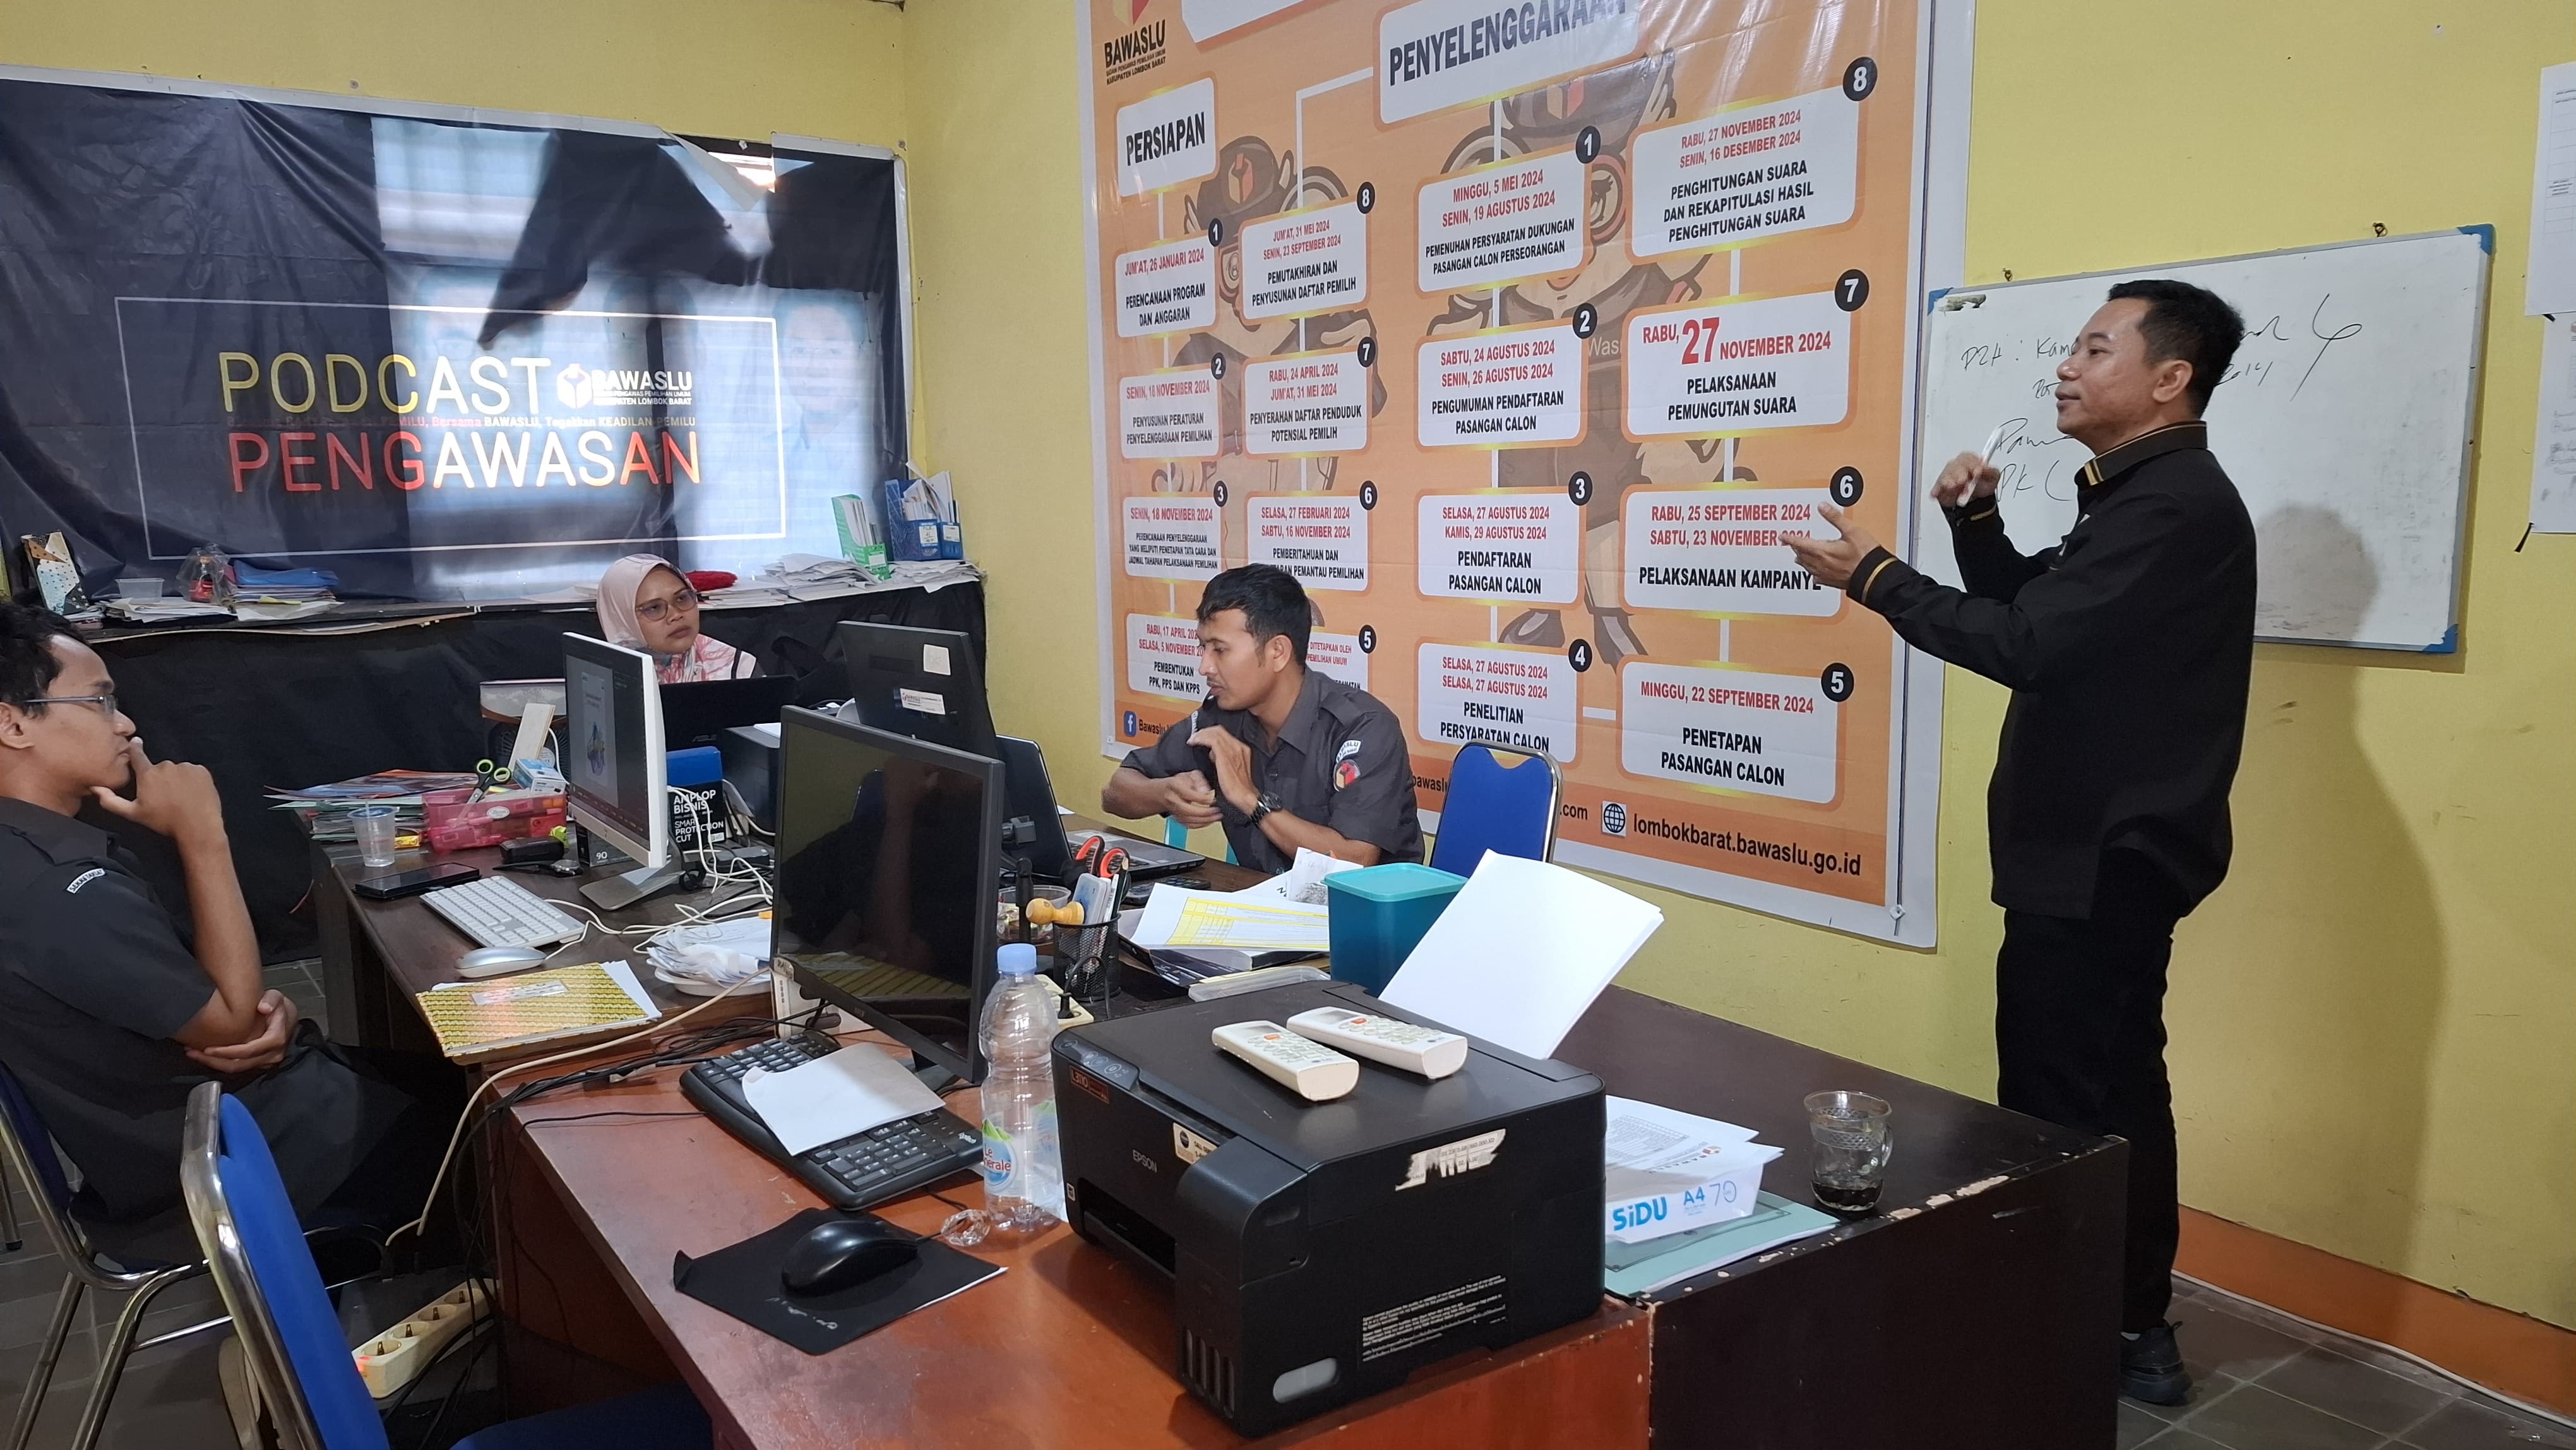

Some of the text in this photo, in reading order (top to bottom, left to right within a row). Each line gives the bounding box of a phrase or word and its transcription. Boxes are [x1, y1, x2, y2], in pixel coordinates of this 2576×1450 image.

[1104, 19, 1166, 68] BAWASLU
[1107, 57, 1166, 85] KABUPATEN LOMBOK BARAT
[1854, 66, 1867, 92] 8
[1126, 112, 1205, 166] PERSIAPAN
[1585, 134, 1592, 156] 1
[1453, 169, 1543, 203] MINGGU, 5 MEI 2024
[1671, 160, 1808, 200] PENGHITUNGAN SUARA
[1362, 189, 1369, 207] 8
[1664, 181, 1813, 222] DAN REKAPITULASI HASIL
[1213, 227, 1217, 240] 1
[1426, 218, 1574, 258] PEMENUHAN PERSYARATAN DUKUNGAN
[1125, 248, 1204, 276] JUM'AT, 26 JANUARI 2024
[1433, 240, 1565, 275] PASANGAN CALON PERSEORANGAN
[1266, 260, 1337, 284] PEMUTAKHIRAN DAN
[1126, 283, 1205, 309] PERENCANAAN PROGRAM
[1253, 277, 1356, 306] PENYUSUNAN DAFTAR PEMILIH
[1844, 279, 1859, 303] 7
[1140, 306, 1190, 327] DAN ANGGARAN
[1580, 311, 1590, 332] 2
[1643, 317, 1830, 364] RABU, 27 NOVEMBER 2024
[1363, 344, 1370, 361] 7
[1215, 358, 1222, 374] 2
[1270, 362, 1338, 383] RABU, 24 APRIL 2024
[218, 352, 551, 415] PODCAST
[591, 369, 693, 390] BAWASLU
[1688, 371, 1776, 395] PELAKSANAAN
[1433, 390, 1563, 414] PENGUMUMAN PENDAFTARAN
[1668, 395, 1797, 421] PEMUNGUTAN SUARA
[484, 416, 543, 428] BAWASLU,
[598, 417, 652, 427] KEADILAN
[657, 417, 696, 426] PEMILU
[1133, 412, 1203, 428] PENYUSUNAN PERATURAN
[1250, 405, 1361, 426] PENYERAHAN DAFTAR PENDUDUK
[1454, 416, 1538, 434] PASANGAN CALON
[1127, 429, 1212, 445] PENYELENGGARAAN PEMILIHAN
[1272, 426, 1337, 442] POTENSIAL PEMILIH
[228, 431, 700, 493] PENGAWASAN
[1217, 487, 1224, 501] 3
[1365, 487, 1372, 503] 6
[1575, 478, 1585, 498] 3
[1840, 476, 1853, 498] 6
[1261, 506, 1350, 521] SELASA, 27 FEBRUARI 2024
[1273, 548, 1338, 561] PEMBERITAHUAN DAN
[1457, 551, 1531, 568] PENDAFTARAN
[1294, 565, 1327, 577] PEMANTAU
[1329, 568, 1364, 580] PEMILIHAN
[1640, 566, 1736, 587] PELAKSANAAN
[1449, 575, 1541, 594] PASANGAN CALON
[1364, 632, 1371, 648] 5
[1575, 645, 1585, 666] 4
[1154, 661, 1194, 677] PEMBENTUKAN
[1443, 657, 1547, 680] SELASA, 27 AGUSTUS 2024
[1149, 676, 1200, 694] PPK, PPS DAN KPPS
[1831, 671, 1844, 693] 5
[1642, 681, 1813, 714] MINGGU, 22 SEPTEMBER 2024
[1464, 702, 1524, 724] PENELITIAN
[1681, 728, 1761, 755] PENETAPAN
[1662, 752, 1784, 786] PASANGAN CALON
[675, 818, 698, 829] SMAR
[676, 821, 724, 836] PROTCTION
[676, 834, 692, 842] CUT
[1634, 814, 1861, 875] lombokbarat.bawaslu.go.id
[596, 851, 607, 860] 90
[1133, 1149, 1157, 1173] EPSON
[1684, 1186, 1705, 1206] A4
[1709, 1180, 1737, 1206] 70
